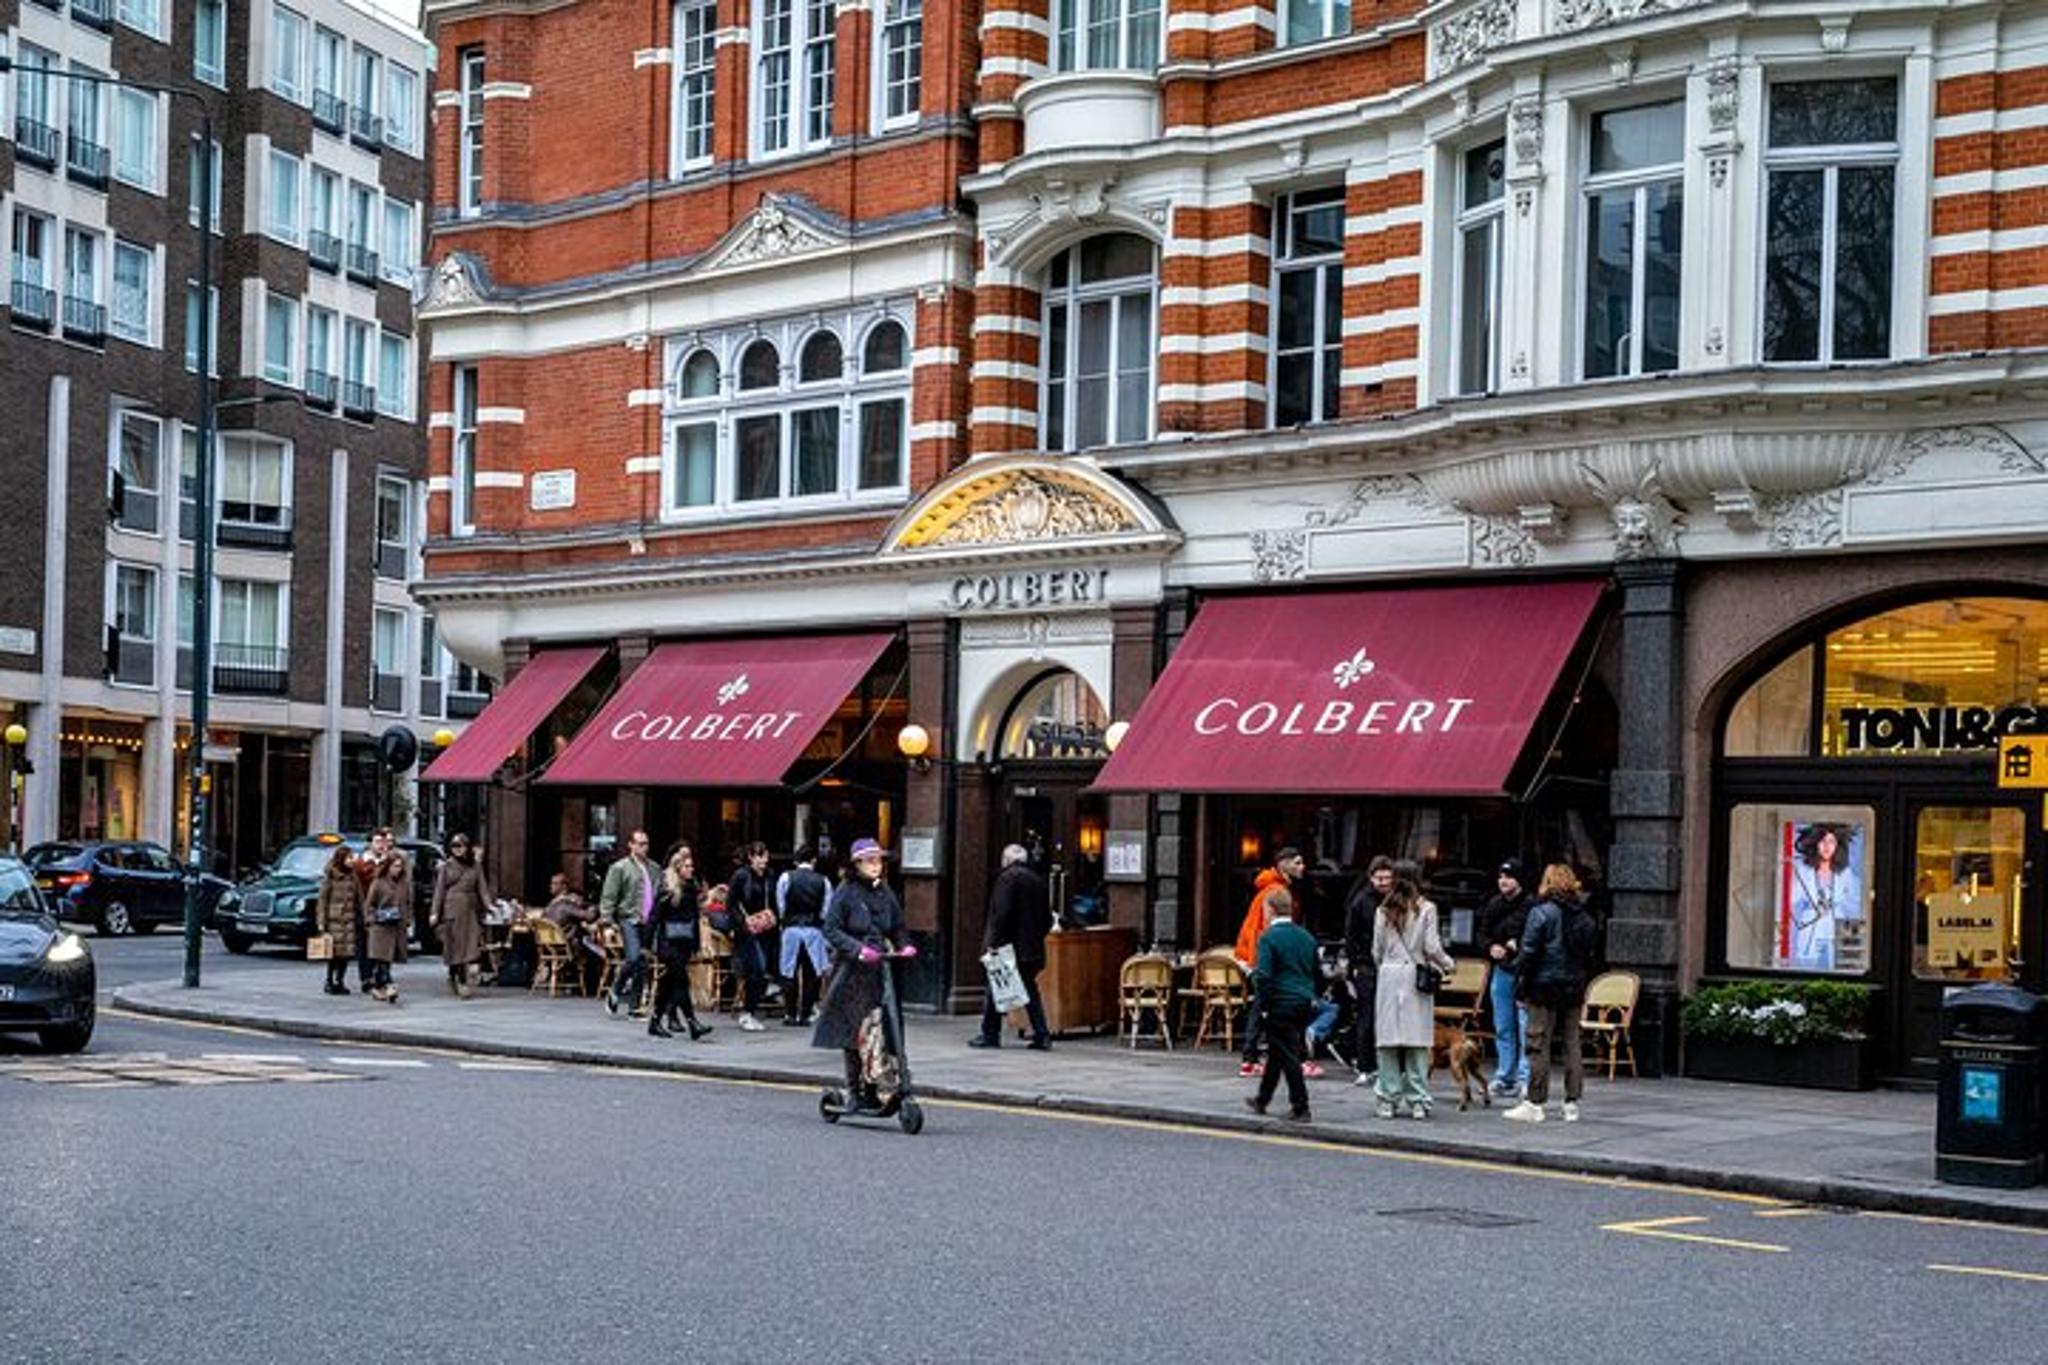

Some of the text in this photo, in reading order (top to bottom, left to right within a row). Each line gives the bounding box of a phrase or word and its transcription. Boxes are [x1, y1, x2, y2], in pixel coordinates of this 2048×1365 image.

[951, 570, 1109, 612] COLBERT
[611, 710, 803, 741] COLBERT
[1194, 698, 1474, 735] COLBERT
